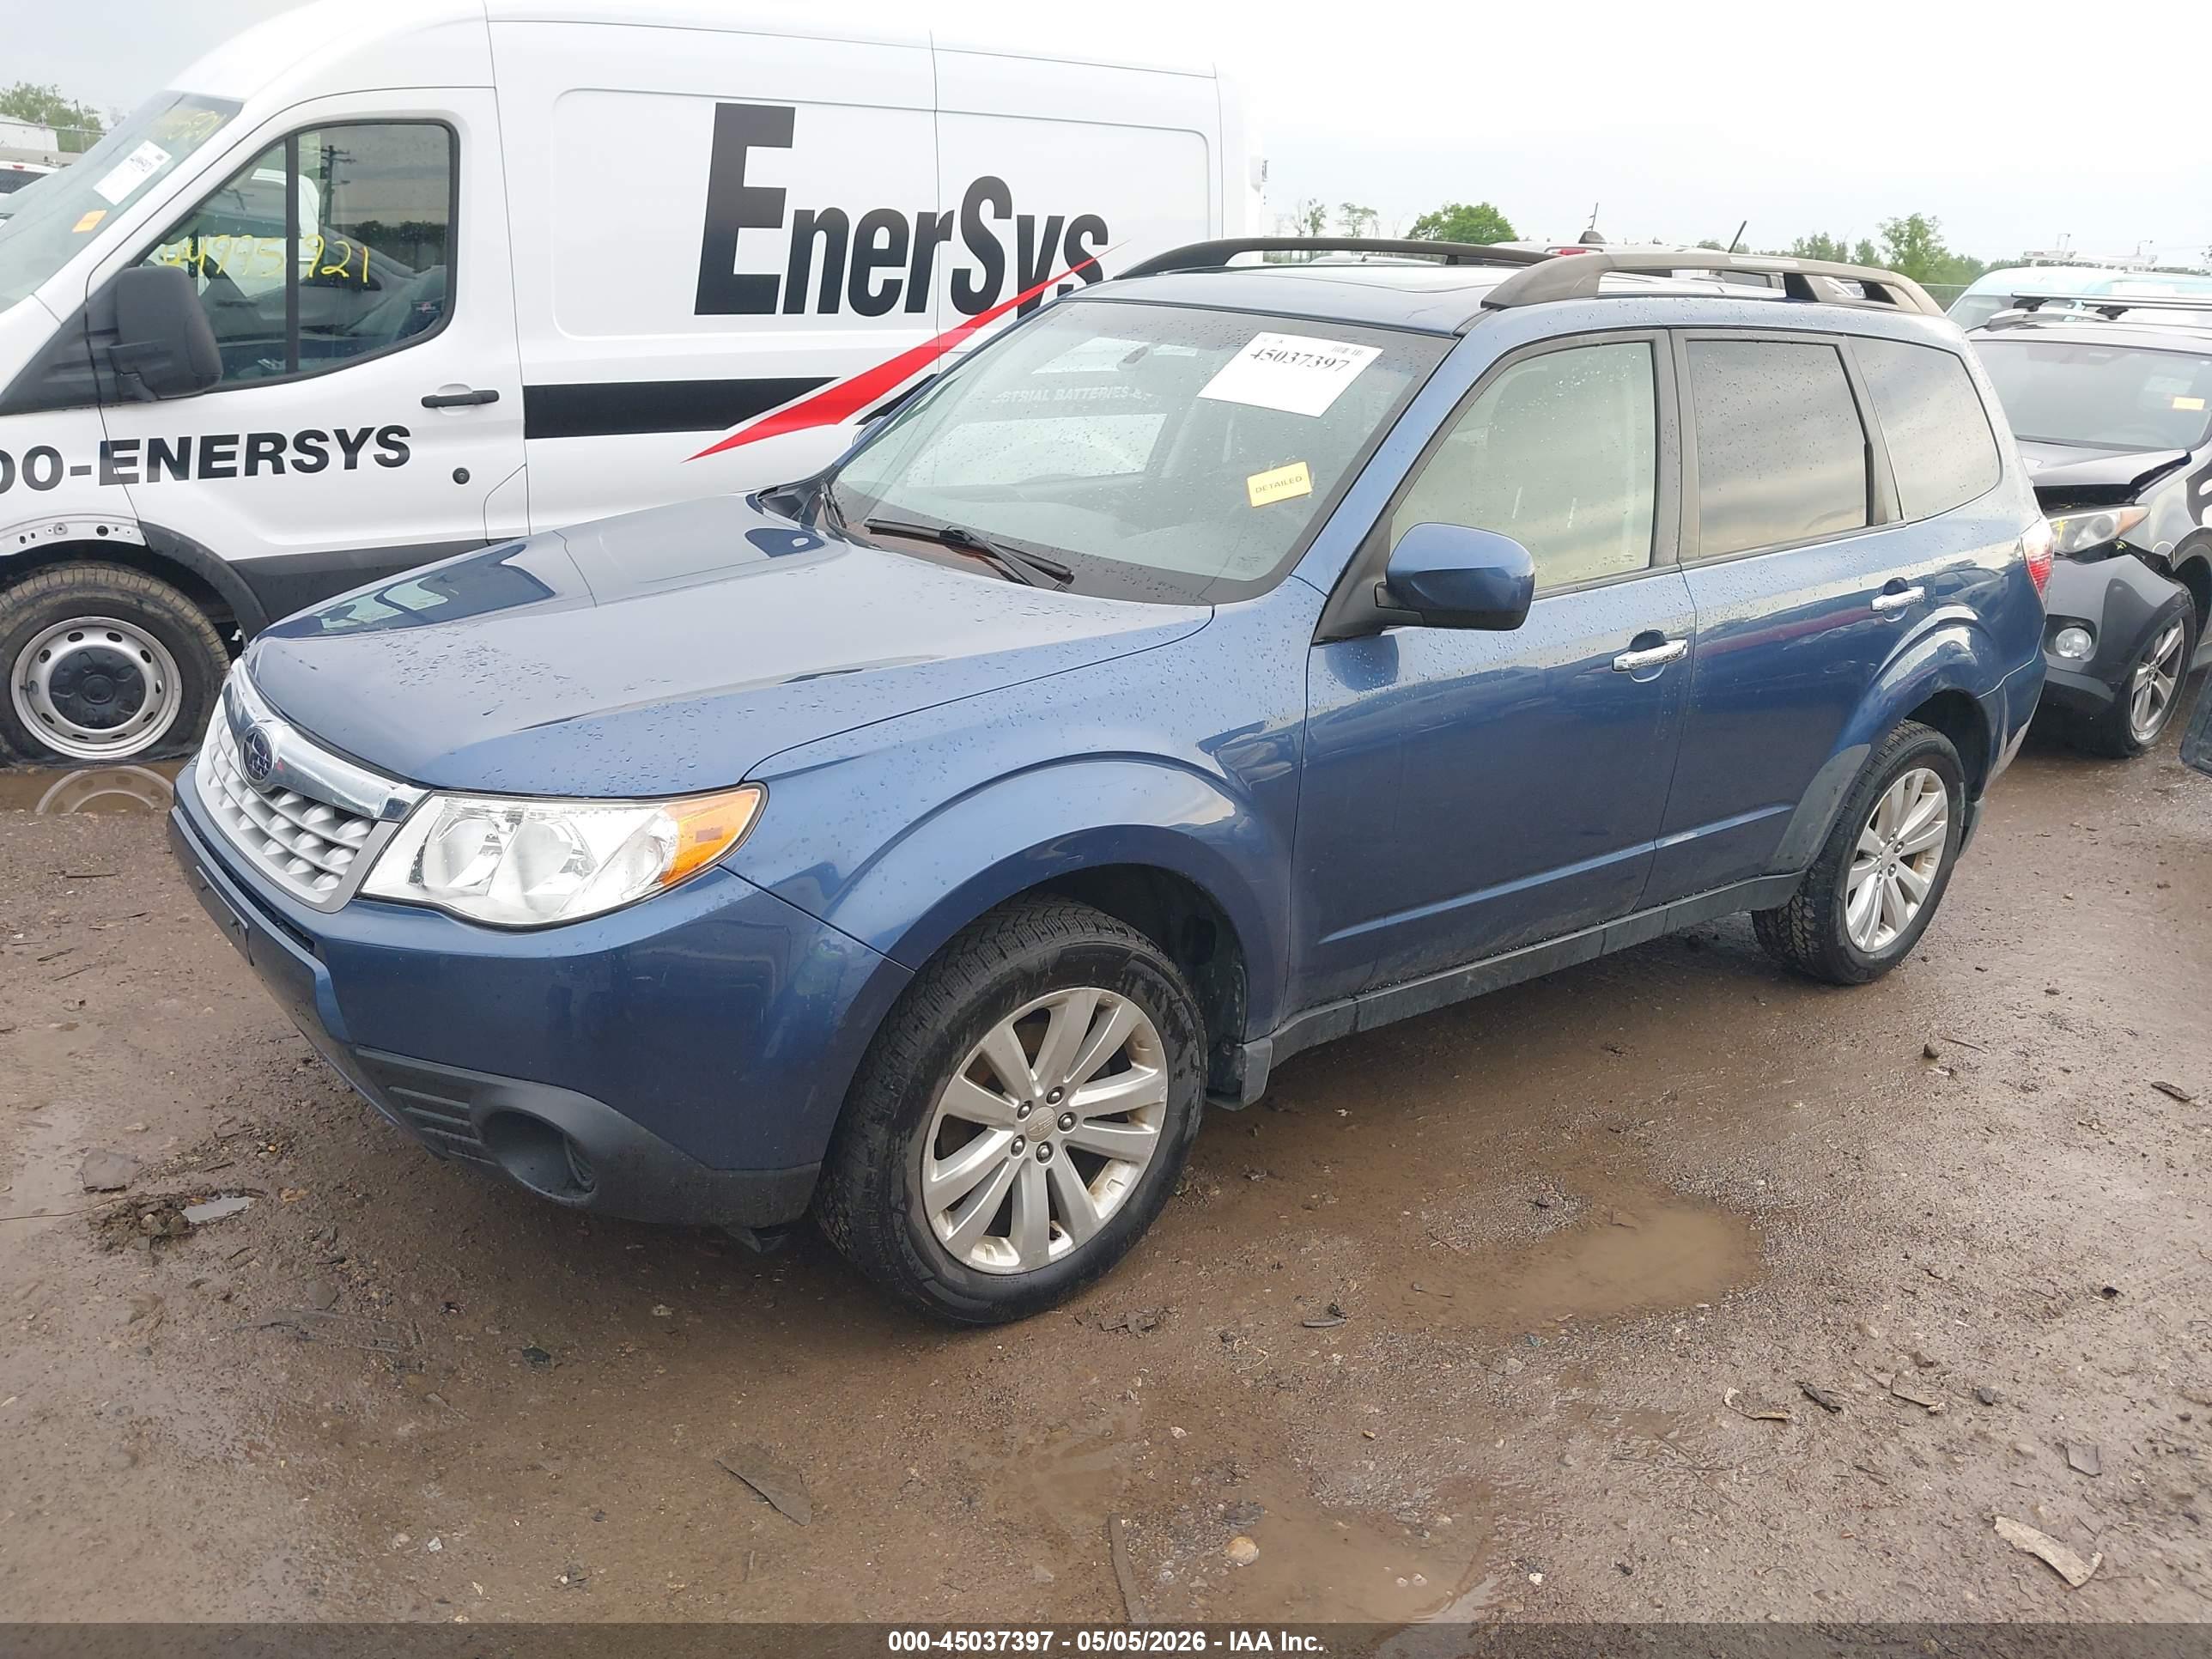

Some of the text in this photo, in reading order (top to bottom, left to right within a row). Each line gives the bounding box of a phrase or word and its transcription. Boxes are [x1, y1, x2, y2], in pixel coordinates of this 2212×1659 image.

[694, 102, 1109, 319] EnerSys
[1249, 348, 1351, 372] 45037397
[1054, 386, 1129, 401] BATTERIES
[1255, 475, 1303, 494] DETAILED
